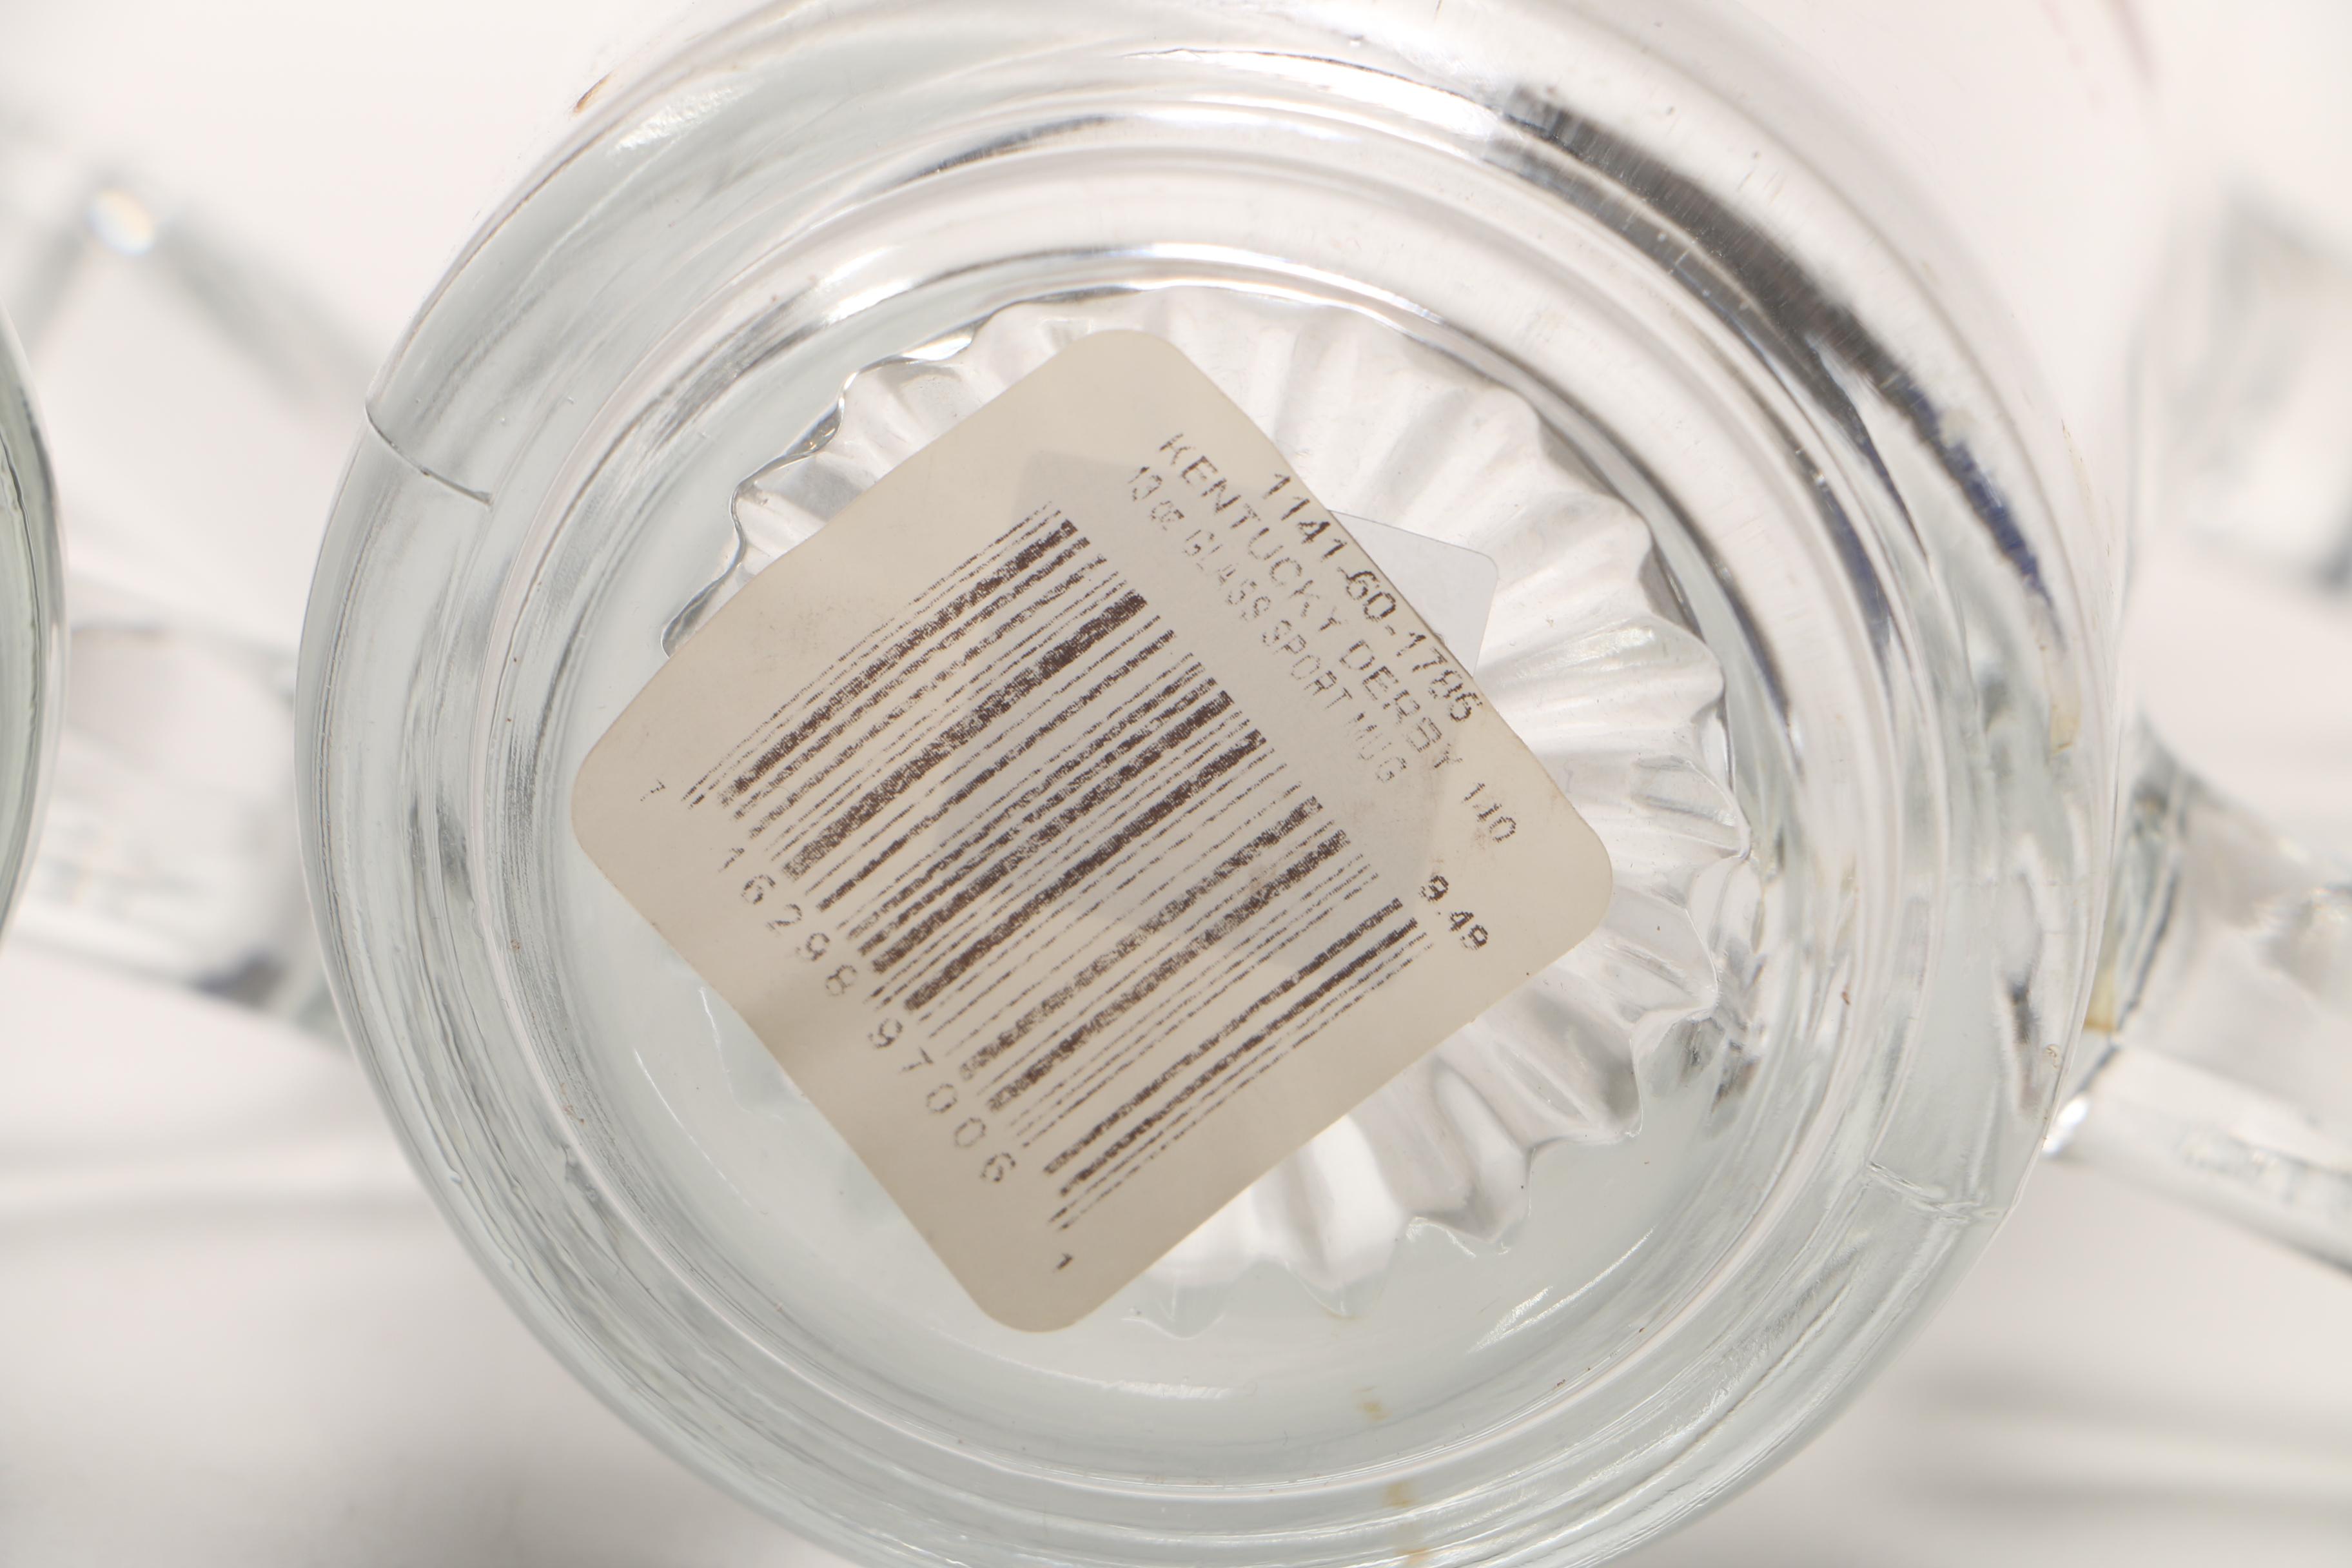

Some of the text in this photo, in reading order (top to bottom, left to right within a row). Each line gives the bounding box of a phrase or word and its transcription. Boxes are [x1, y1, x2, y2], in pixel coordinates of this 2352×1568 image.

[1128, 466, 1162, 502] 13
[1182, 529, 1271, 621] GLASS
[1262, 619, 1353, 710] SPORT
[1343, 711, 1407, 783] MUG
[1159, 432, 1346, 633] KENTUCKY
[1338, 639, 1463, 769] DERBY
[1261, 473, 1484, 723] 1141-60-1786
[718, 846, 858, 997] 16298
[868, 1018, 1017, 1184] 97006
[1052, 1253, 1075, 1272] 1
[1418, 874, 1489, 950] 9.49
